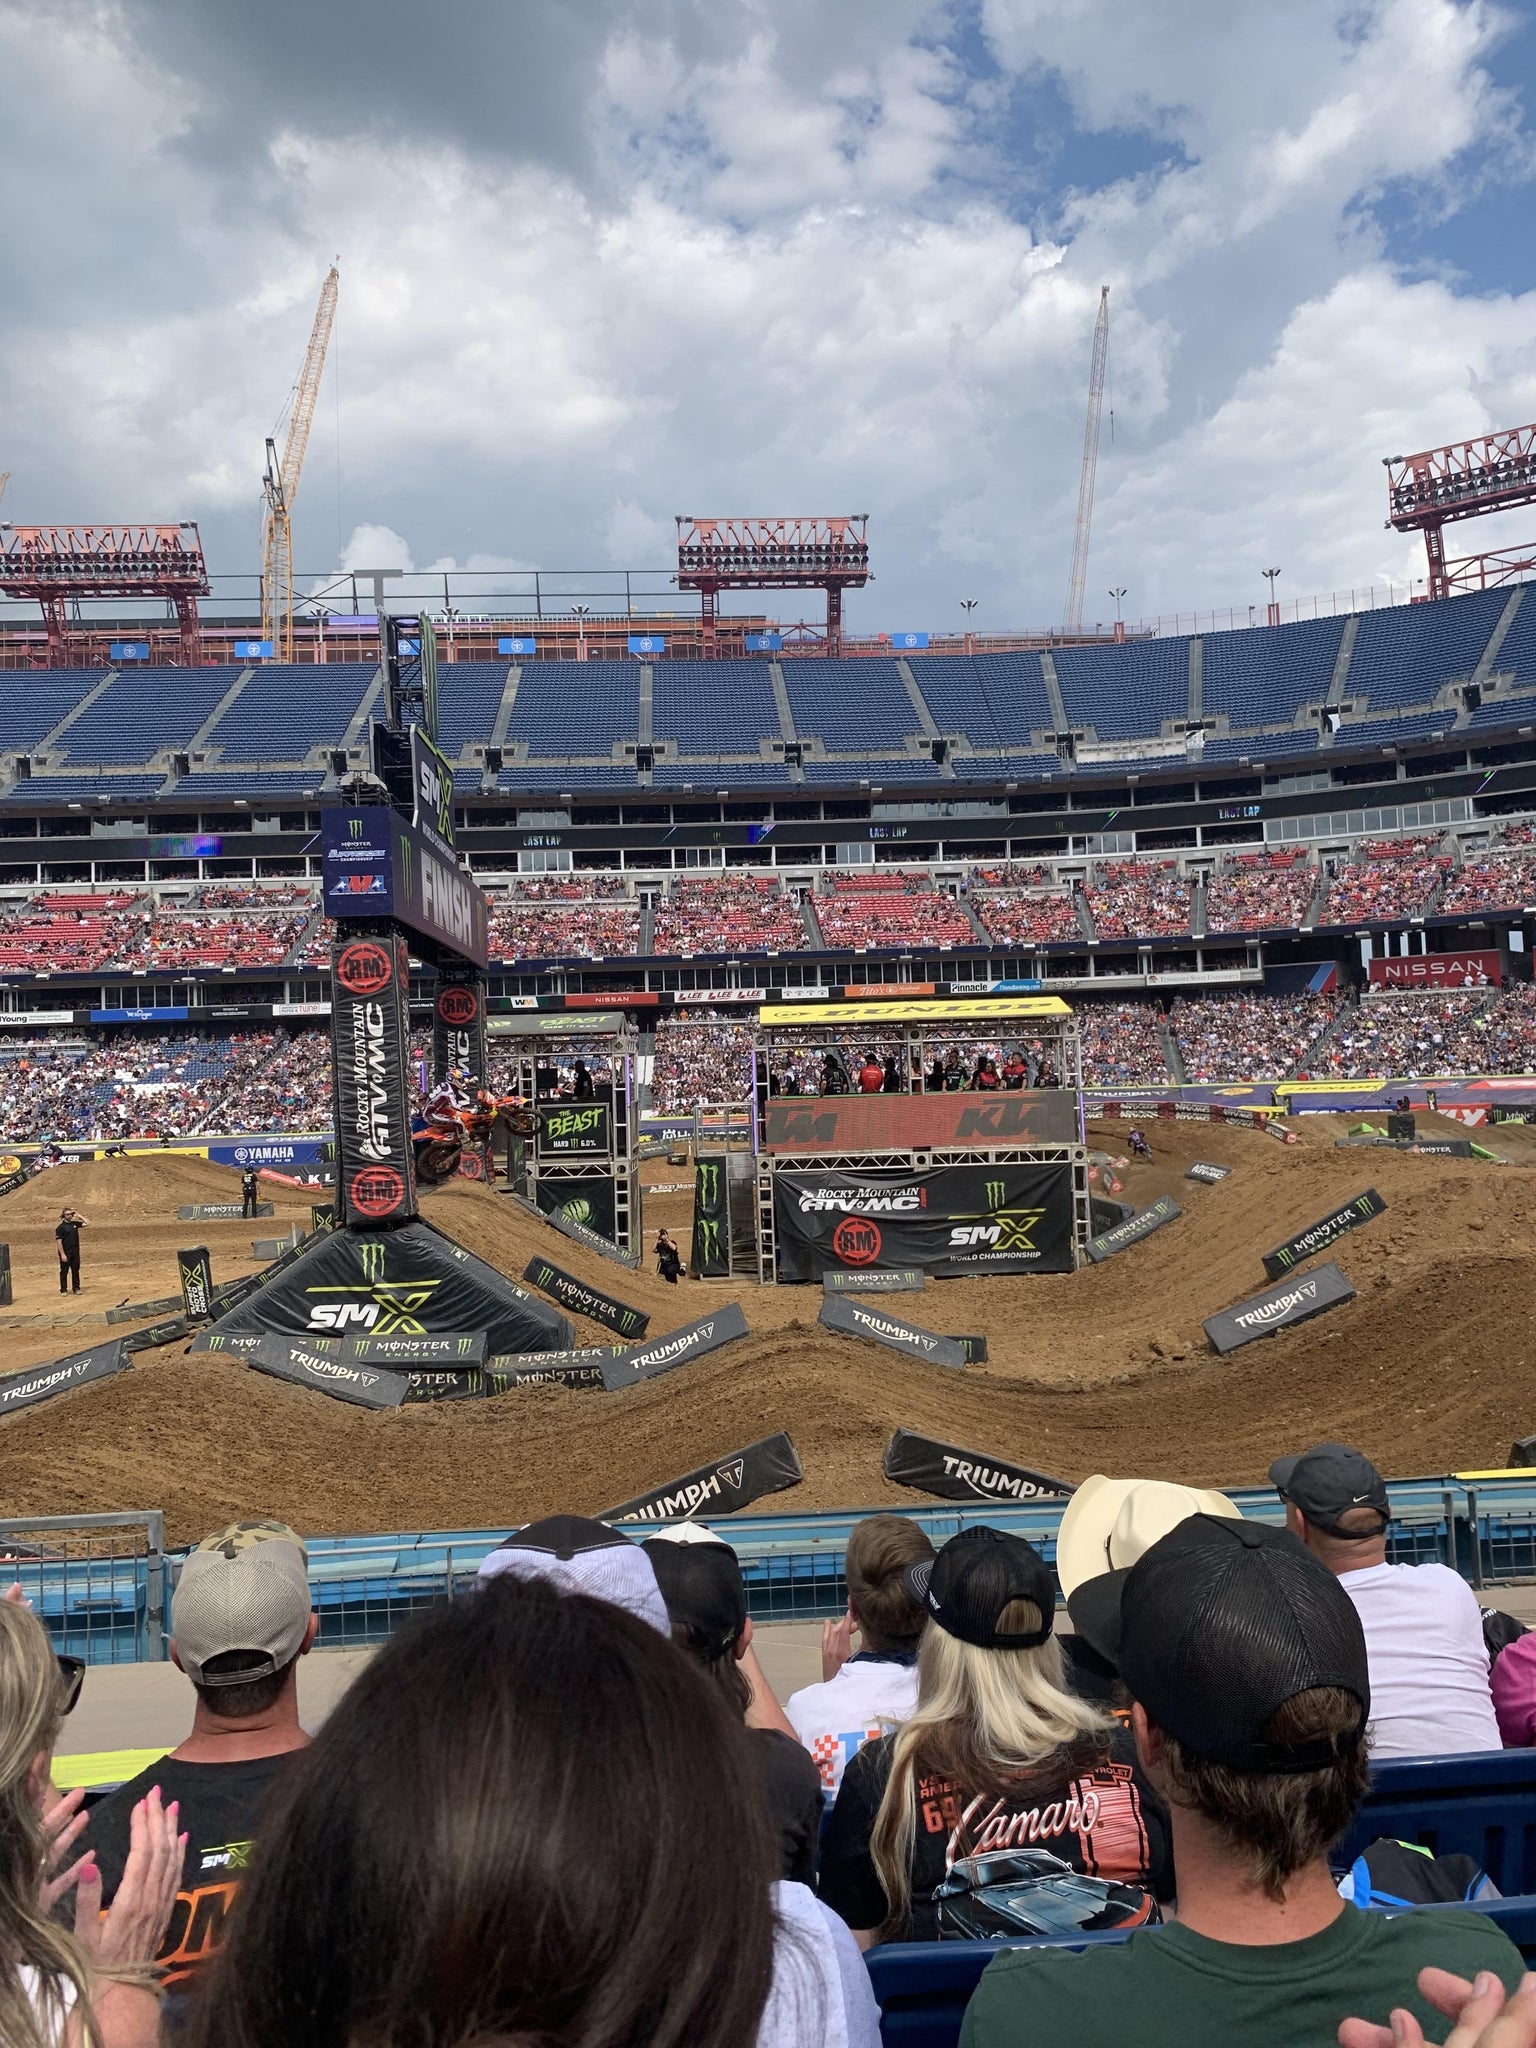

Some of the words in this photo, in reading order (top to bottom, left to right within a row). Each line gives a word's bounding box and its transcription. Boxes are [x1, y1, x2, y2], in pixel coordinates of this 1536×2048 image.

[420, 760, 455, 846] SMX
[1243, 805, 1260, 817] LAP
[523, 836, 544, 846] LAST
[545, 835, 562, 846] LAP
[328, 875, 387, 893] AMA
[420, 847, 472, 950] FINISH
[1386, 959, 1484, 978] NISSAN
[952, 983, 988, 992] Pinnacle
[818, 1002, 1053, 1018] DUNLOP
[353, 1003, 368, 1085] MOUNTAIN
[356, 1087, 370, 1136] ROCKY
[547, 1108, 604, 1140] BEAST
[559, 1109, 571, 1117] THE
[248, 1146, 295, 1160] YAMAHA
[553, 1140, 569, 1148] HARD
[1420, 1146, 1452, 1154] ONSTER
[818, 1188, 855, 1199] ROCKY
[856, 1187, 920, 1198] MOUNTAIN
[203, 1205, 243, 1213] MONSTER
[573, 1222, 617, 1251] MONSTER
[948, 1217, 1041, 1250] SMX
[1108, 1211, 1155, 1242] MONSTER
[1294, 1208, 1356, 1252] MONSTER
[1310, 1224, 1351, 1254] ENERGY
[950, 1254, 978, 1262] WORLD
[979, 1251, 1042, 1261] CHAMPIONSHIP
[848, 1273, 901, 1282] MONSTER
[192, 1286, 202, 1313] MOTO
[555, 1277, 617, 1318] MONSTER
[561, 1294, 604, 1321] ENERGY
[1235, 1290, 1304, 1329] TRIUMPH
[306, 1291, 437, 1335] SMX
[853, 1309, 920, 1345] TRIUMPH
[376, 1340, 450, 1352] MONSTER
[518, 1348, 604, 1363] MONSTER
[630, 1331, 700, 1371] TRIUMPH
[289, 1349, 359, 1382] TRIUMPH
[2, 1365, 74, 1402] TRIUMPH
[942, 1455, 1056, 1499] TRIUMPH
[945, 1792, 1100, 1869] Camaro
[200, 1846, 250, 1869] SMX
